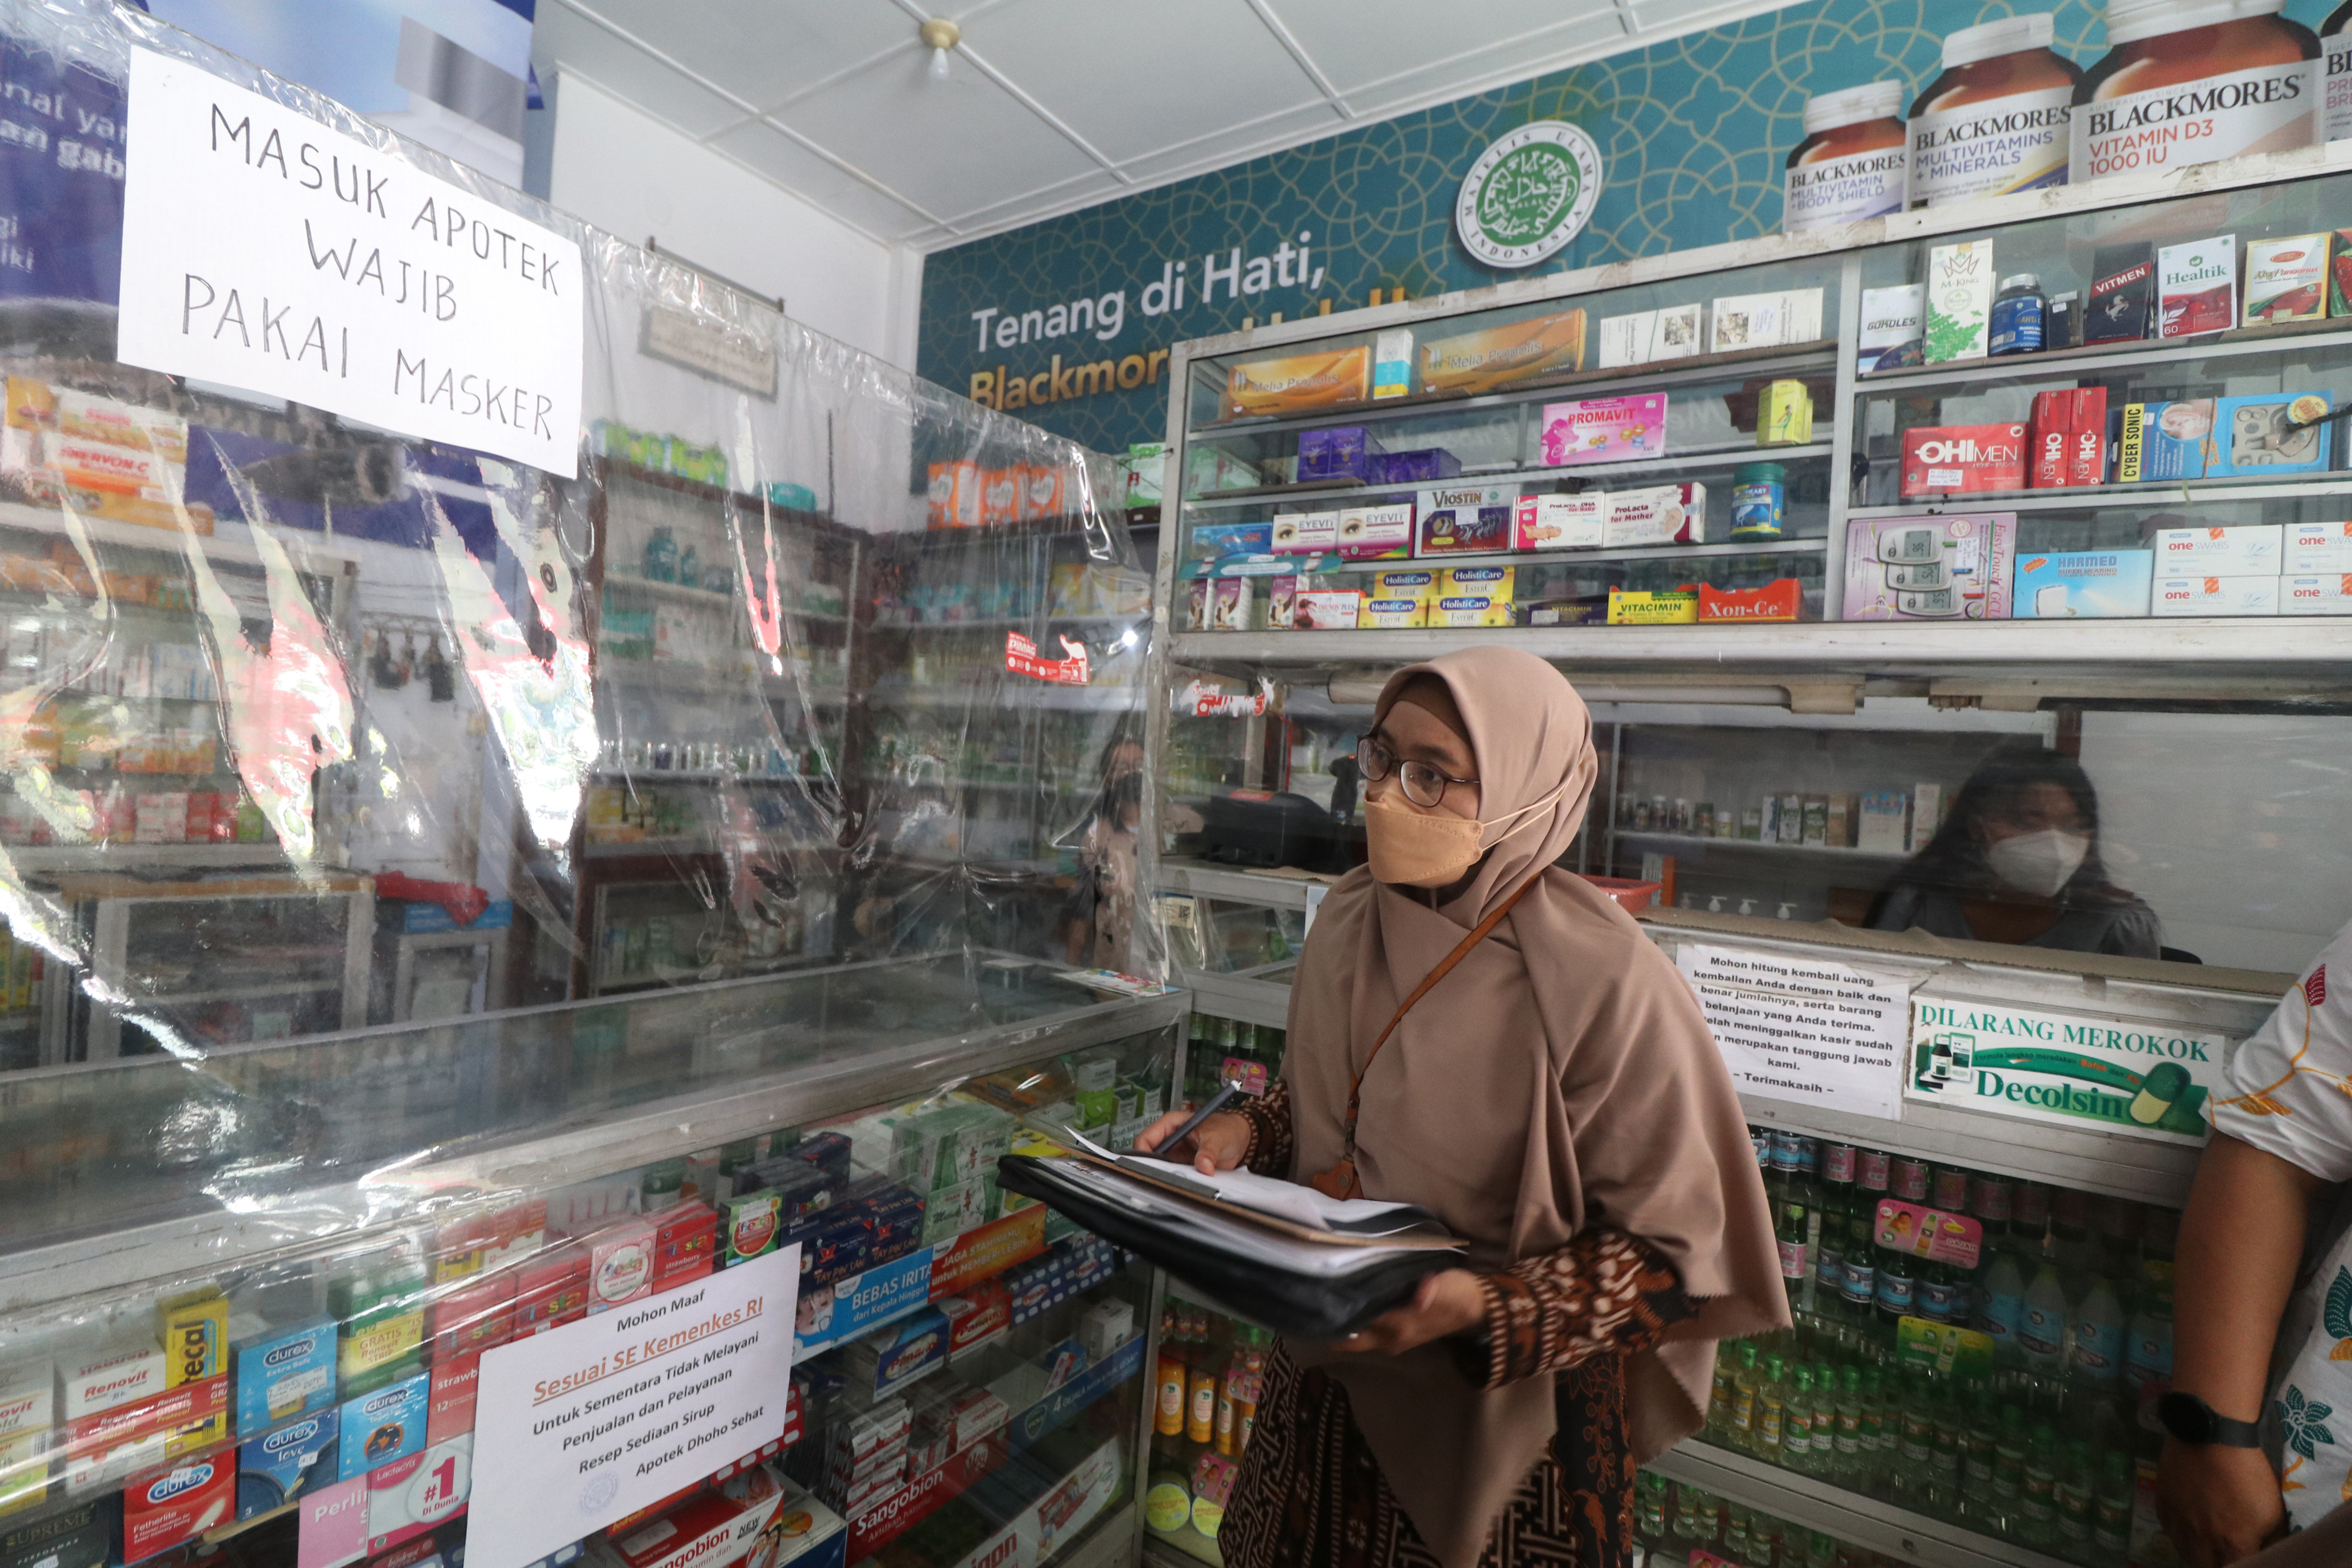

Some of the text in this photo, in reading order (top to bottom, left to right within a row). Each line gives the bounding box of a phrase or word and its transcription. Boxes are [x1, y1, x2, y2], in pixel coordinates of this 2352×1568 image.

[2088, 74, 2301, 137] BLACKMORES
[1915, 105, 2072, 151] BLACKMORES
[2090, 119, 2214, 159] VITAMIN D3
[1915, 131, 2054, 169] MULTIVITAMINS
[2089, 146, 2167, 176] 1000 IU
[1790, 152, 1905, 189] BLACKMORES
[1930, 151, 2022, 180] MINERALS
[211, 102, 560, 297] MASUK APOTEK
[1790, 175, 1883, 200] MULTIVITAMIN
[1838, 185, 1885, 203] SHIELD
[304, 218, 457, 322] WAJIB
[2096, 267, 2146, 293] VITMEN
[2166, 265, 2228, 285] Healtik
[971, 230, 1326, 354] Tenang di Hati,
[2164, 325, 2179, 335] 60
[182, 273, 553, 442] PAKAI MASKER
[1450, 340, 1542, 370] Melia Propolis
[1252, 372, 1339, 393] Melia Propolis
[1568, 408, 1635, 425] PROMAVIT
[2123, 408, 2141, 477] CYBER SONIC
[1432, 491, 1482, 508] VIOSTIN
[1615, 504, 1649, 513] ProLacta
[1624, 512, 1654, 521] Mother
[2169, 540, 2229, 551] one SWABS
[2299, 536, 2325, 546] one
[2058, 556, 2117, 568] HARMED
[1386, 575, 1429, 584] HolistiCare
[1455, 570, 1502, 580] HolistiCare
[1442, 599, 1488, 609] HolistiCare
[2165, 590, 2190, 600] one
[2294, 588, 2320, 599] one
[1371, 602, 1414, 611] HolistiCare
[1621, 603, 1682, 612] VITACIMIN
[1708, 600, 1779, 617] Xon-Ce
[1710, 957, 1875, 987] Mohon hitung kembali uang
[1693, 970, 1891, 1002] kembalian Anda dengan baik dan
[1701, 985, 1882, 1018] benar jumlahnya, serta barang
[1705, 1001, 1875, 1032] belanjaan yang Anda terima.
[1734, 1021, 1816, 1041] meninggalkan
[1820, 1034, 1851, 1045] kasir
[1855, 1037, 1893, 1051] sudah
[1920, 1004, 2210, 1064] DILARANG MEROKOK
[1725, 1035, 1892, 1068] merupakan tanggung jawab
[1768, 1058, 1800, 1071] kami.
[2080, 1058, 2107, 1073] Batuk
[1744, 1072, 1822, 1094] Terimakasih
[1974, 1068, 2123, 1119] Decolsin
[665, 1253, 700, 1269] strawberry
[942, 1250, 968, 1268] JAGA
[852, 1263, 933, 1310] BEBAS IRITA
[932, 1269, 958, 1286] untuk
[616, 1289, 706, 1333] Mohon Maaf
[853, 1288, 925, 1322] dari Kepala Hingga
[359, 1328, 402, 1350] GRATIS
[533, 1296, 763, 1403] Sesuai SE Kemenkes RI
[269, 1343, 310, 1363] durex
[84, 1368, 150, 1399] Renovit
[533, 1331, 759, 1436] Untuk Sementara Tidak Melayani
[366, 1390, 405, 1411] durex
[436, 1400, 449, 1413] 12
[562, 1368, 733, 1451] Penjualan dan Pelayanan
[269, 1424, 313, 1449] durex
[578, 1402, 716, 1475] Resep Sediaan Sirup
[636, 1405, 764, 1477] Apotek Dhoho Sehat
[278, 1445, 305, 1463] love
[422, 1495, 459, 1516] Di Dunia
[856, 1470, 943, 1536] Sangobion
[133, 1511, 177, 1533] Fetherlite
[738, 1516, 761, 1537] NEW
